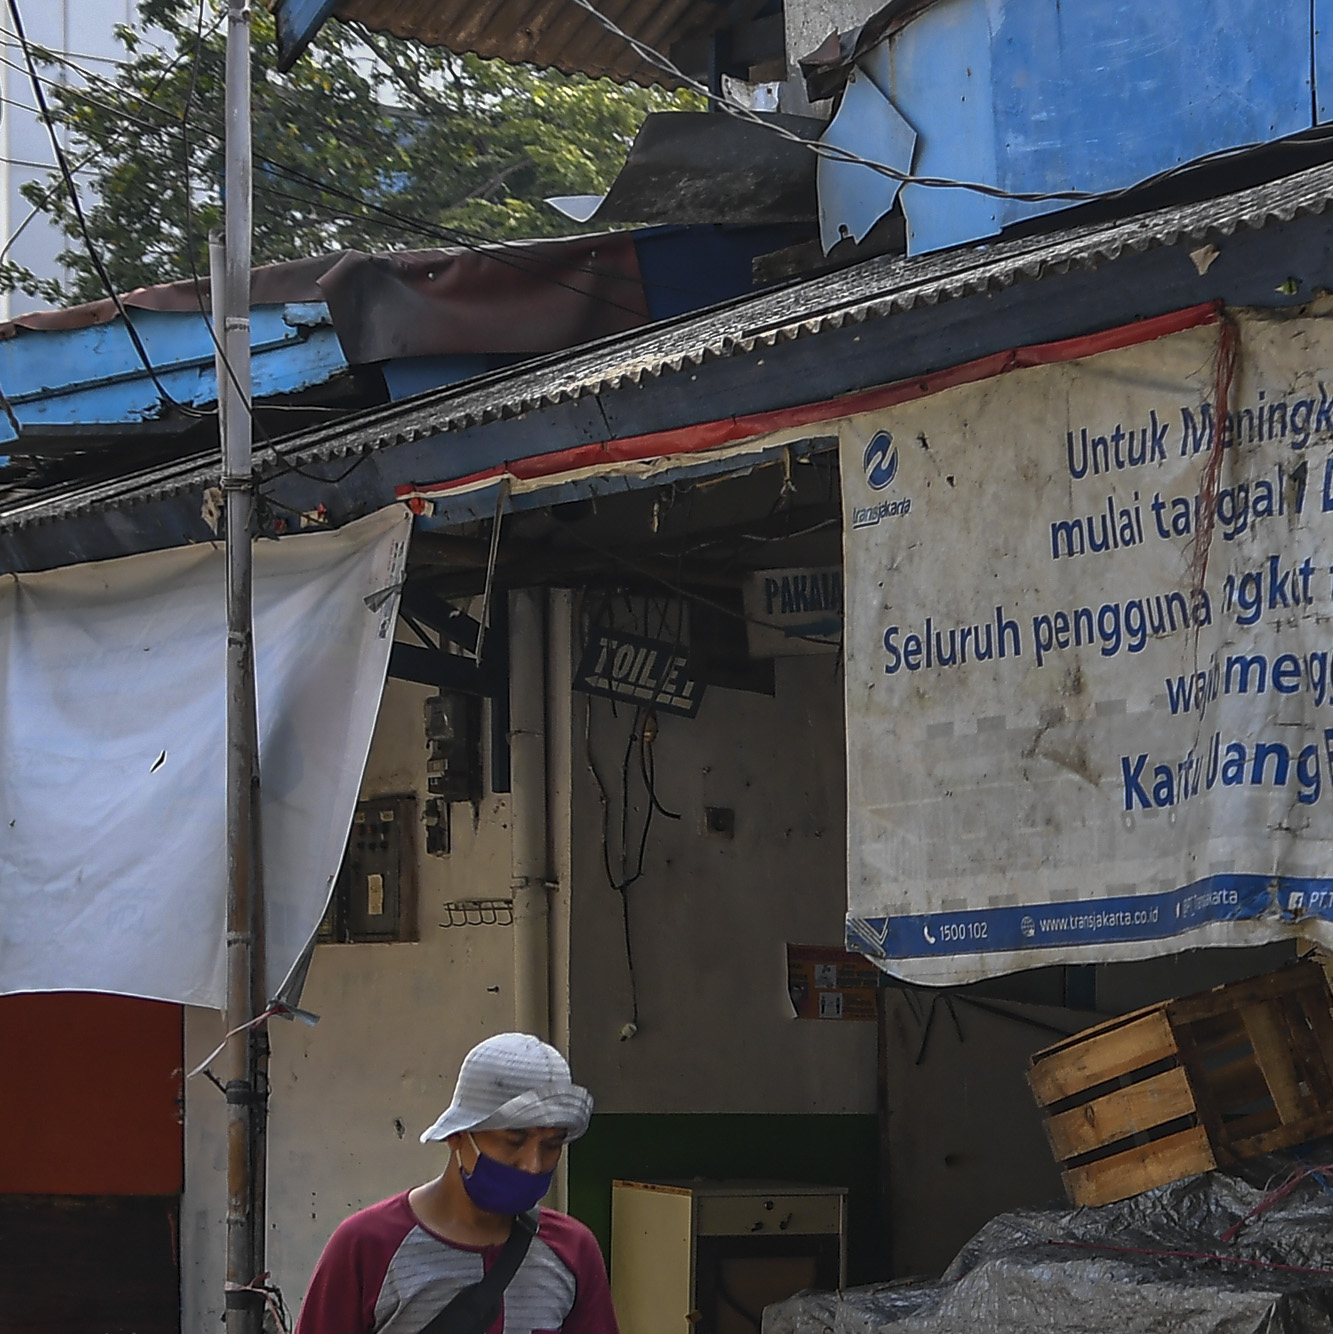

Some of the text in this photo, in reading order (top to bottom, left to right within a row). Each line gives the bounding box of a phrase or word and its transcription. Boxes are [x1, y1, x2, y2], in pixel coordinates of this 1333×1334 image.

[1066, 410, 1170, 480] Untuk
[1051, 491, 1144, 560] mulai
[884, 605, 1022, 675] Seluruh
[1032, 588, 1213, 667] pengguna
[1205, 731, 1321, 805] Uang
[939, 922, 988, 942] 1500 102
[1040, 905, 1159, 934] www.transjakarta.co.id
